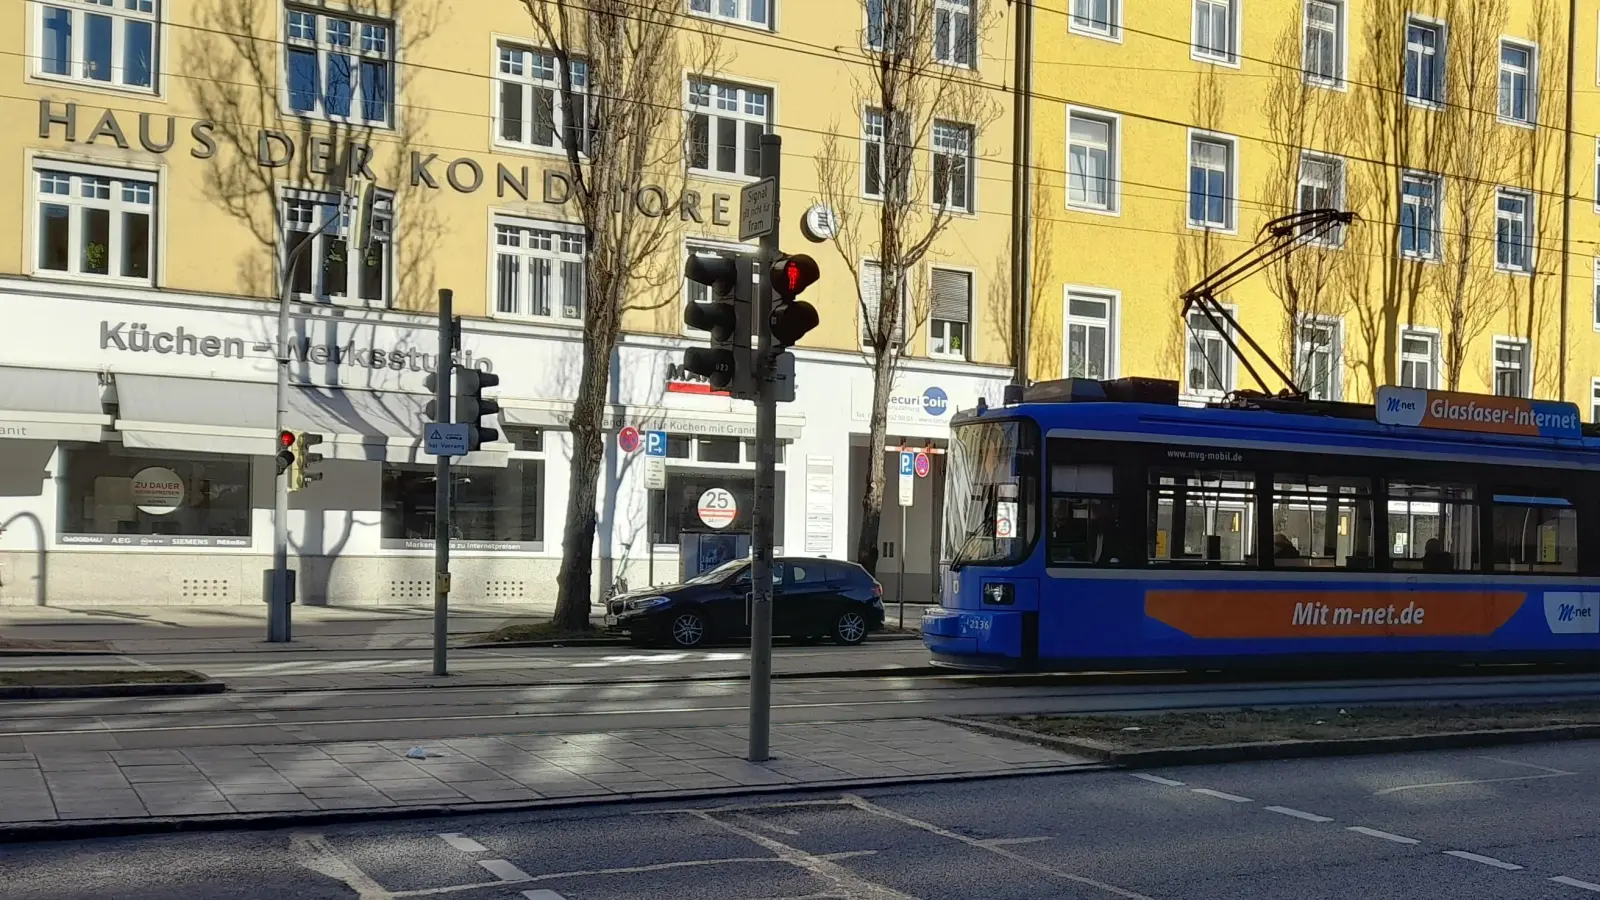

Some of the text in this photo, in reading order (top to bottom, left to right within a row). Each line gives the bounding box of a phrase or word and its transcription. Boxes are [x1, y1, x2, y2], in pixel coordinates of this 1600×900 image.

[38, 99, 217, 159] HAUS
[257, 129, 377, 181] DER
[747, 185, 768, 204] Signal
[748, 220, 764, 232] Tram
[100, 320, 245, 359] Küchen
[1430, 399, 1577, 430] Glasfaser-Internet
[670, 421, 705, 432] Küchen
[709, 424, 724, 434] mit
[727, 425, 756, 436] Granit
[649, 433, 660, 453] P
[901, 454, 910, 473] P
[1167, 450, 1243, 462] www.mvg-mobil.de
[150, 482, 180, 490] DAUER
[705, 491, 728, 509] 25
[466, 542, 521, 551] Internetpreisen
[1292, 601, 1425, 625] Mit m-net.de
[968, 619, 990, 630] 2136
